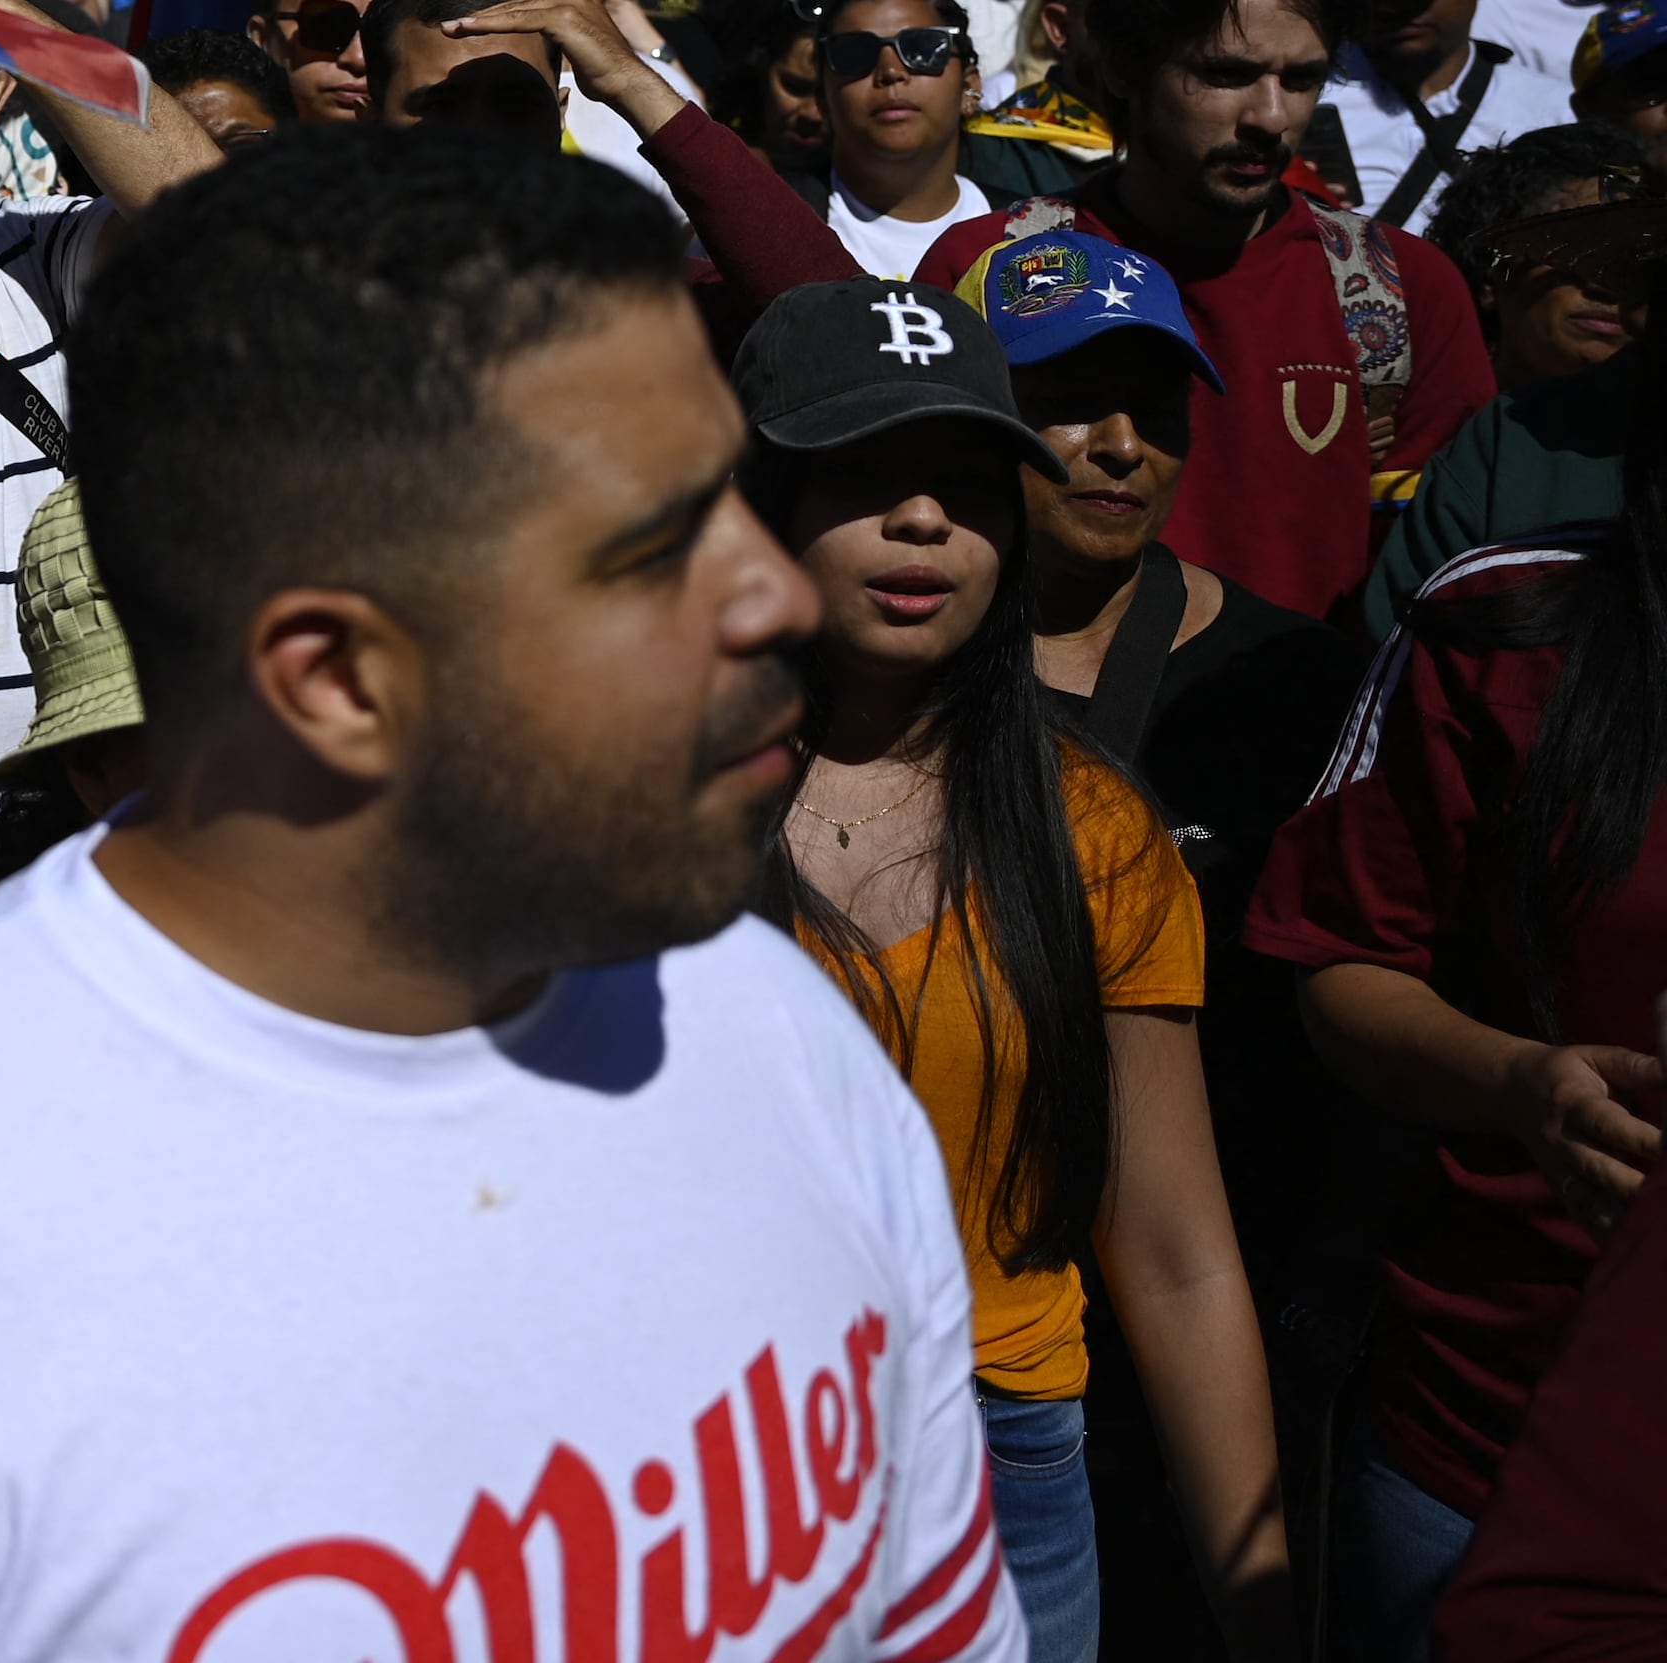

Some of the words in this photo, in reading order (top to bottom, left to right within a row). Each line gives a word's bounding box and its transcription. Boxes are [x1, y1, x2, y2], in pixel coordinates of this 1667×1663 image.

[23, 393, 58, 434] CLUB
[23, 417, 62, 464] RIVER
[165, 1305, 889, 1663] Miller
